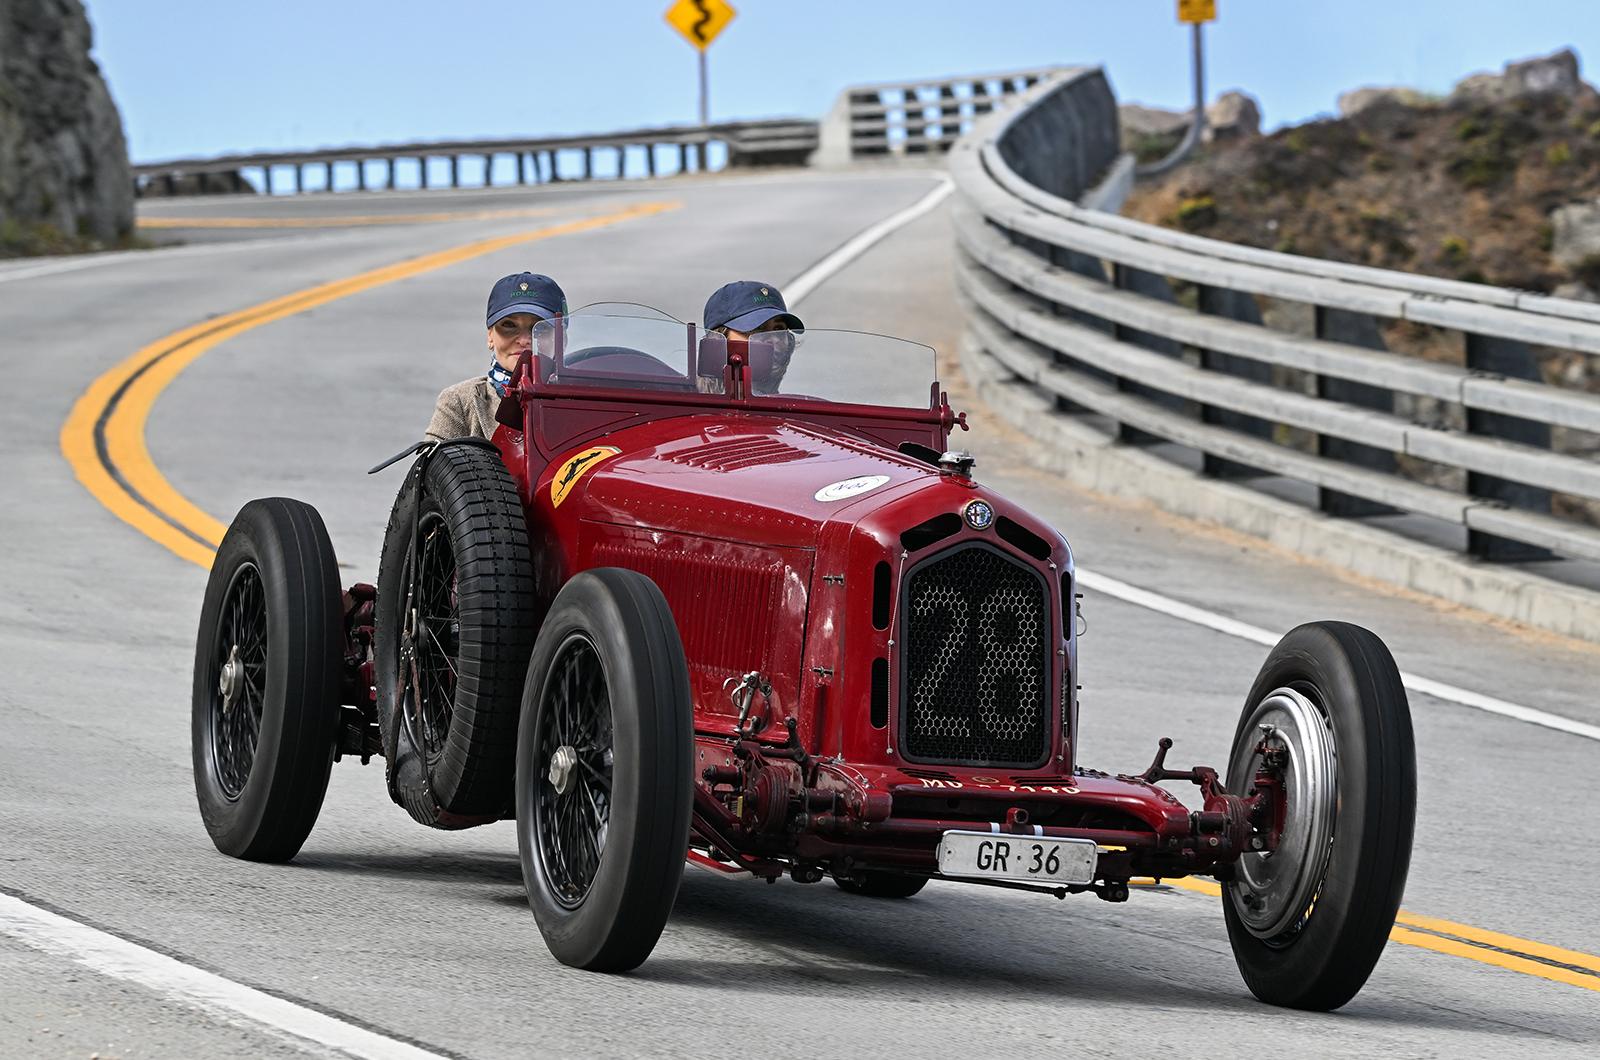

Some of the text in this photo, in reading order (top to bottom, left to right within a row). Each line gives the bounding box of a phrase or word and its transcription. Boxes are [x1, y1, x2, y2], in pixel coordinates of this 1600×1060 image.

[914, 586, 1038, 740] 28
[977, 841, 1011, 872] GR
[1028, 844, 1060, 875] 36
